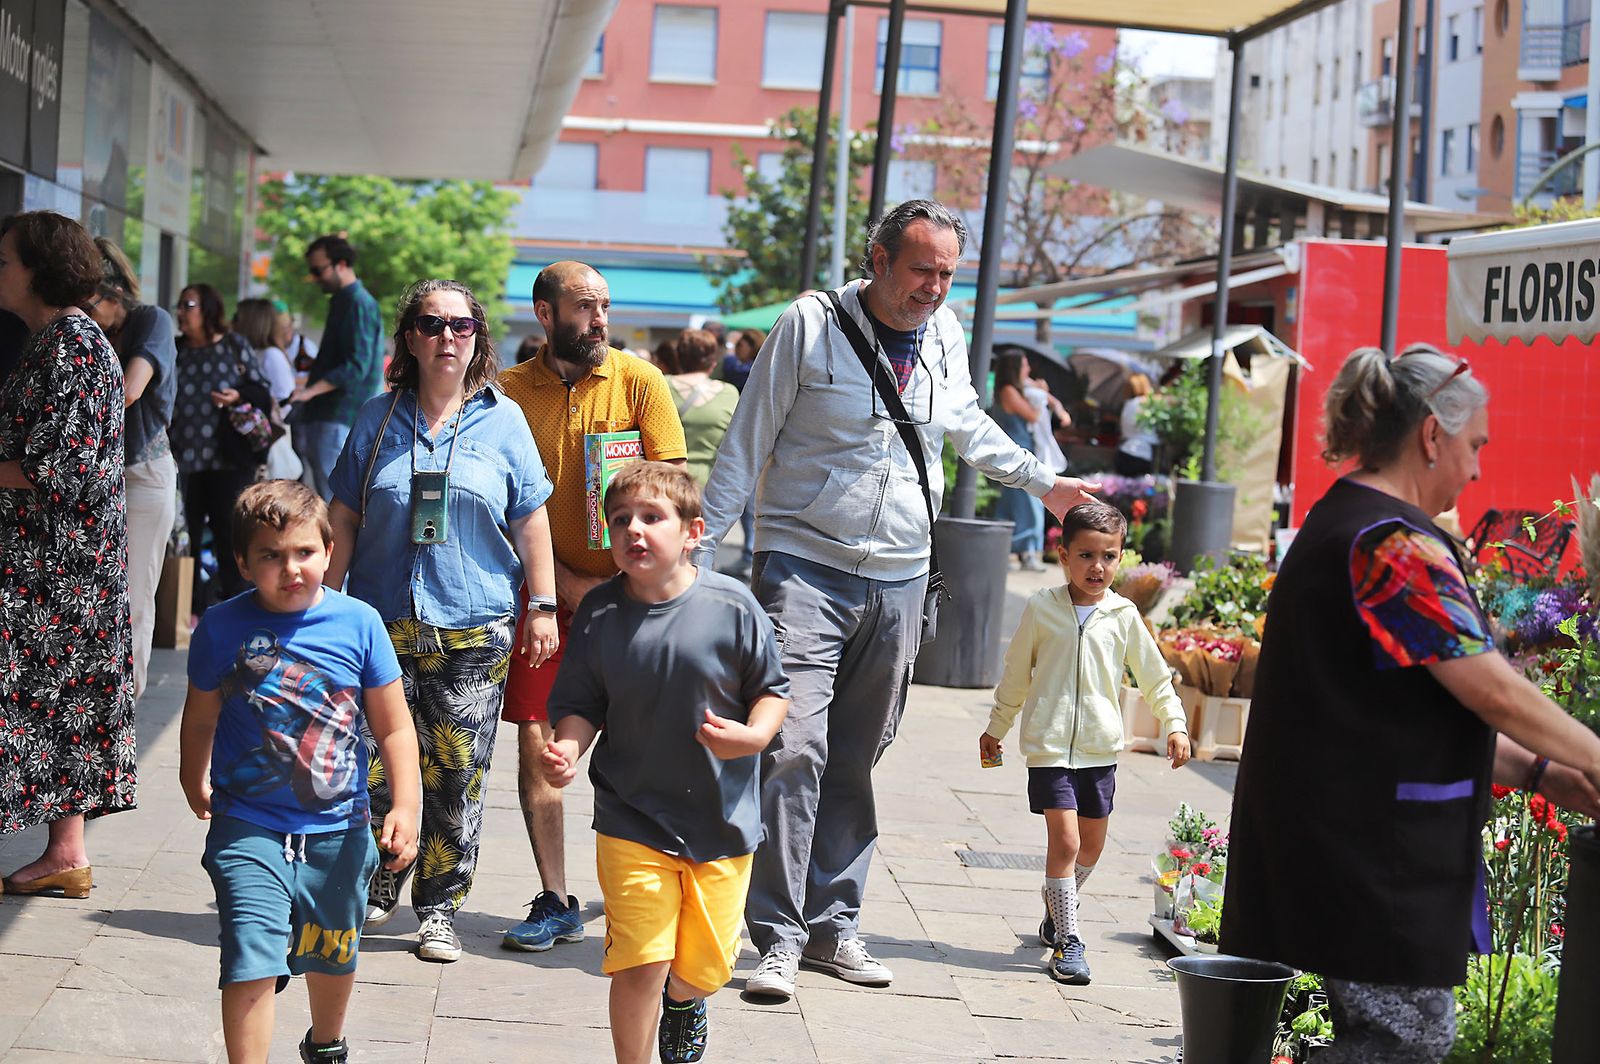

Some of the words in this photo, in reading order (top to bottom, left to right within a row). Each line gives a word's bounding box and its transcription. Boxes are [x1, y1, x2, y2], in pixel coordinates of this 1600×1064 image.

[1483, 258, 1600, 323] FLORIS
[590, 491, 598, 538] MONOPOLY
[296, 922, 356, 964] NYC
